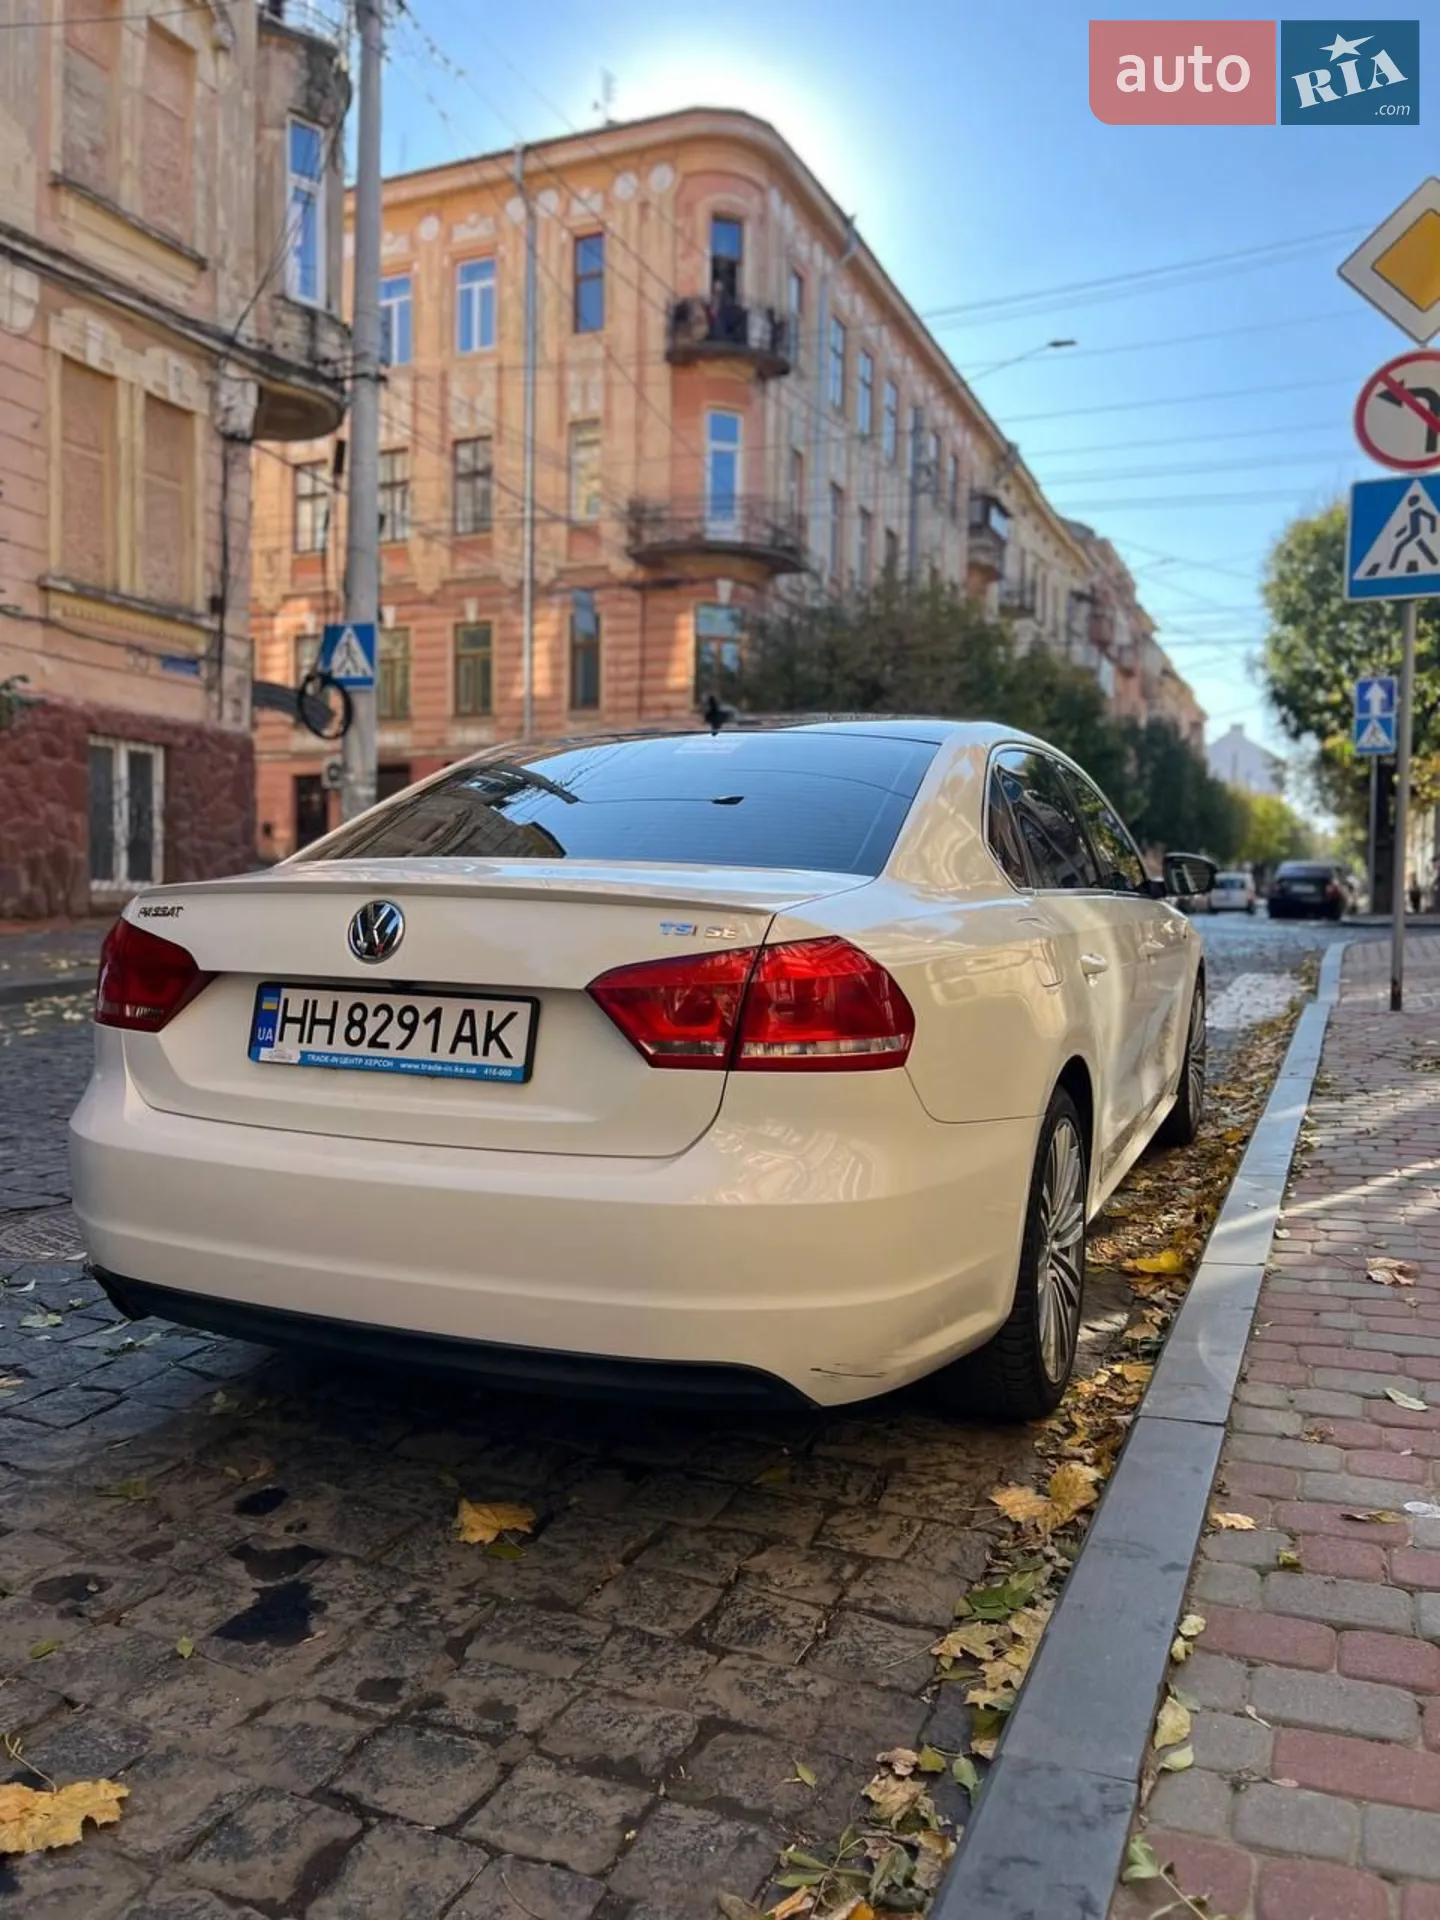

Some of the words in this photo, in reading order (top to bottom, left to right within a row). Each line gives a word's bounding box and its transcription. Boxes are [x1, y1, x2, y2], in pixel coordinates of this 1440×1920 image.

[137, 905, 184, 918] PASSAT
[660, 922, 697, 936] TSI
[257, 1027, 273, 1041] UA
